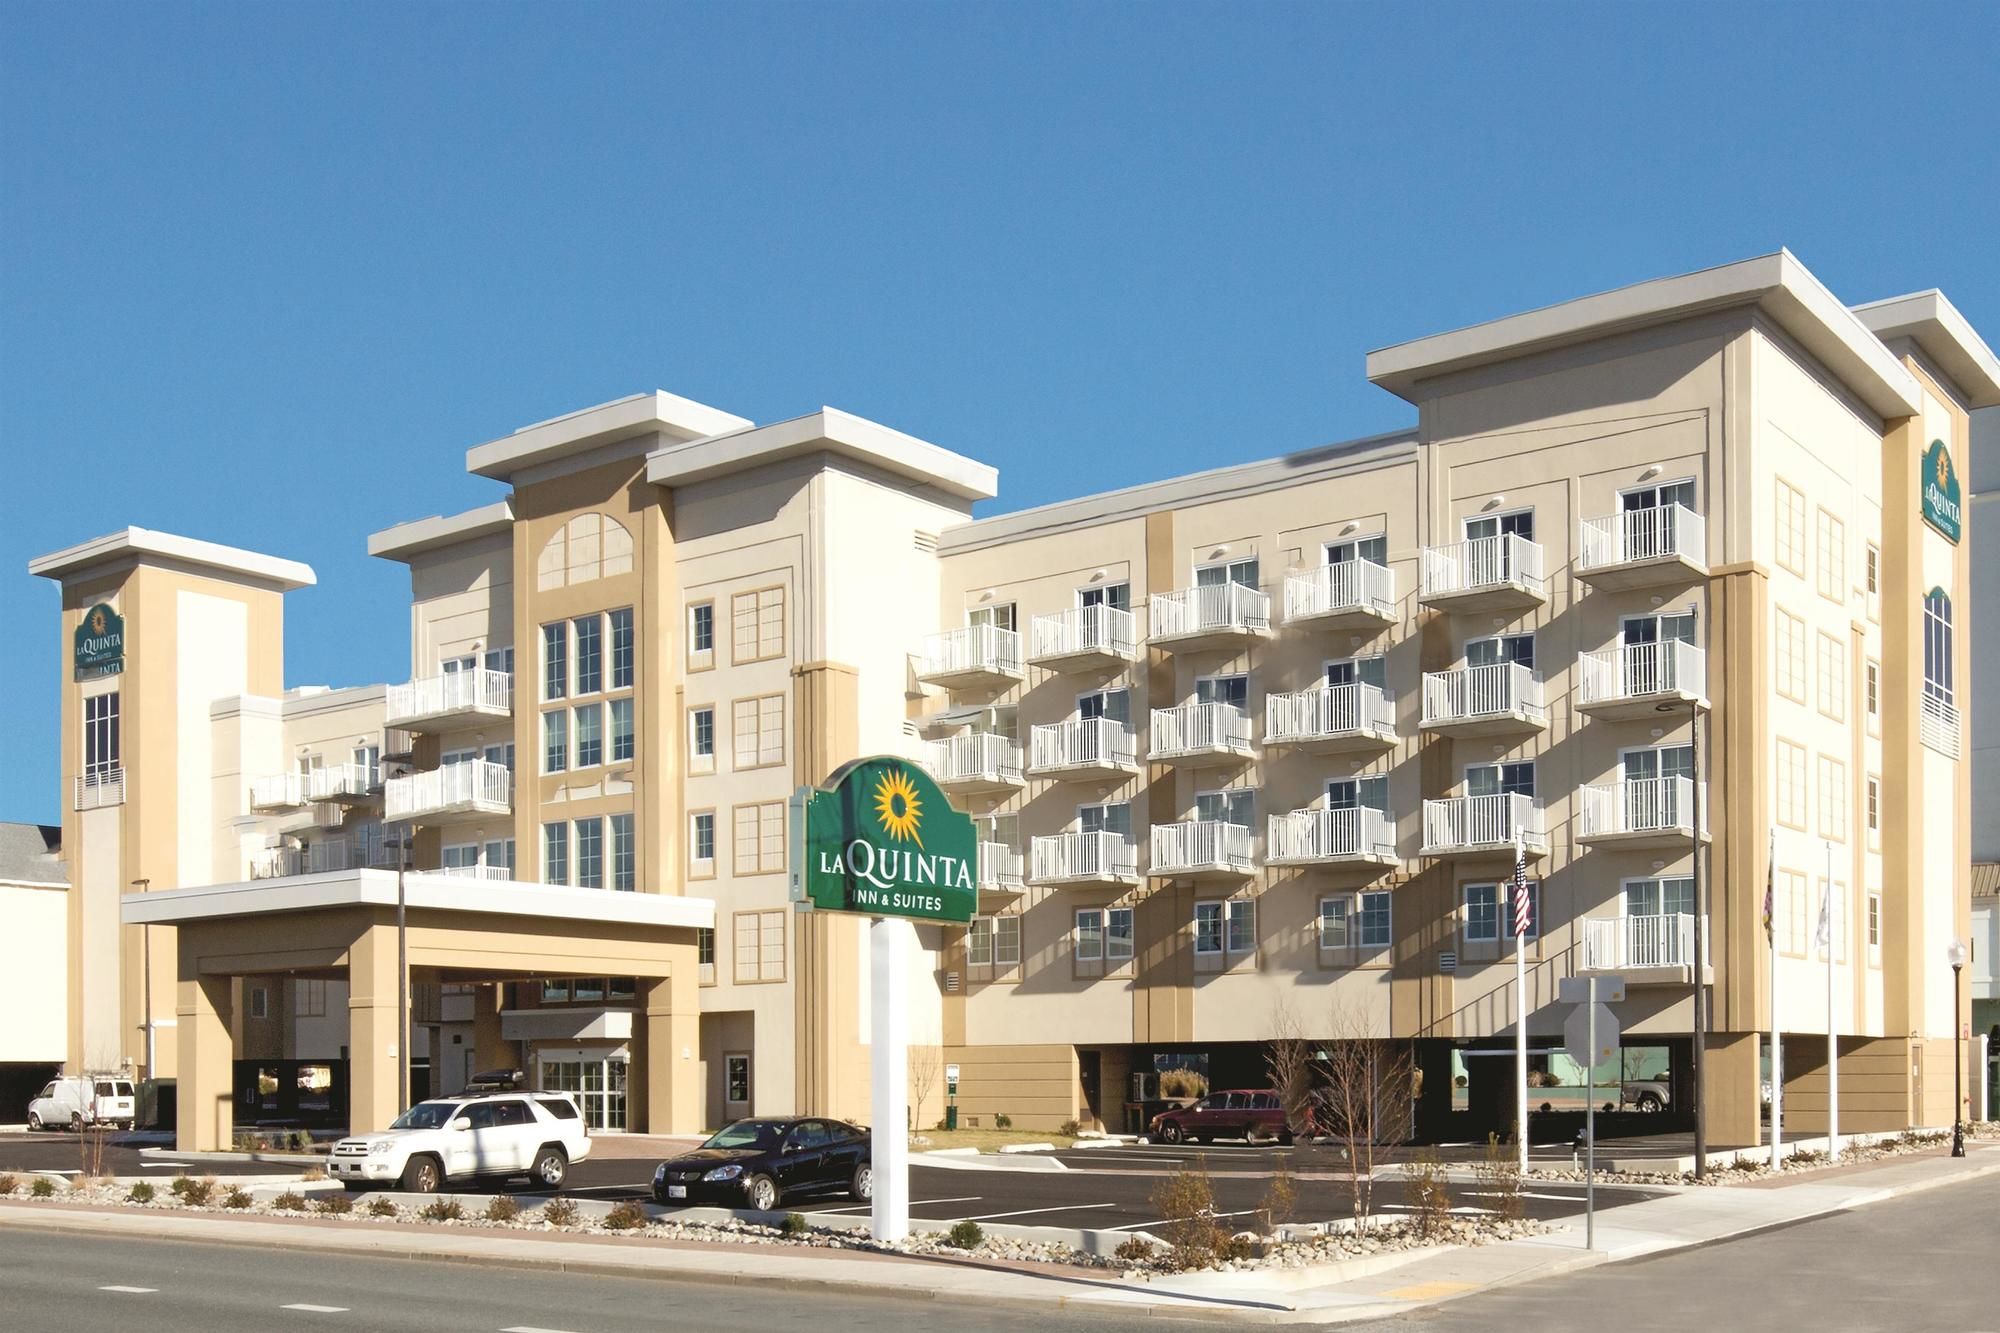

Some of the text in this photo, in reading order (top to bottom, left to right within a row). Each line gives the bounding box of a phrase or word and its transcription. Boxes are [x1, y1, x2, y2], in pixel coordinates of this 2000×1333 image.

[1930, 482, 1960, 525] QUINTA
[77, 633, 121, 656] LA QUINTA
[820, 839, 974, 890] LA QUINTA
[853, 889, 942, 911] INN & SUITES
